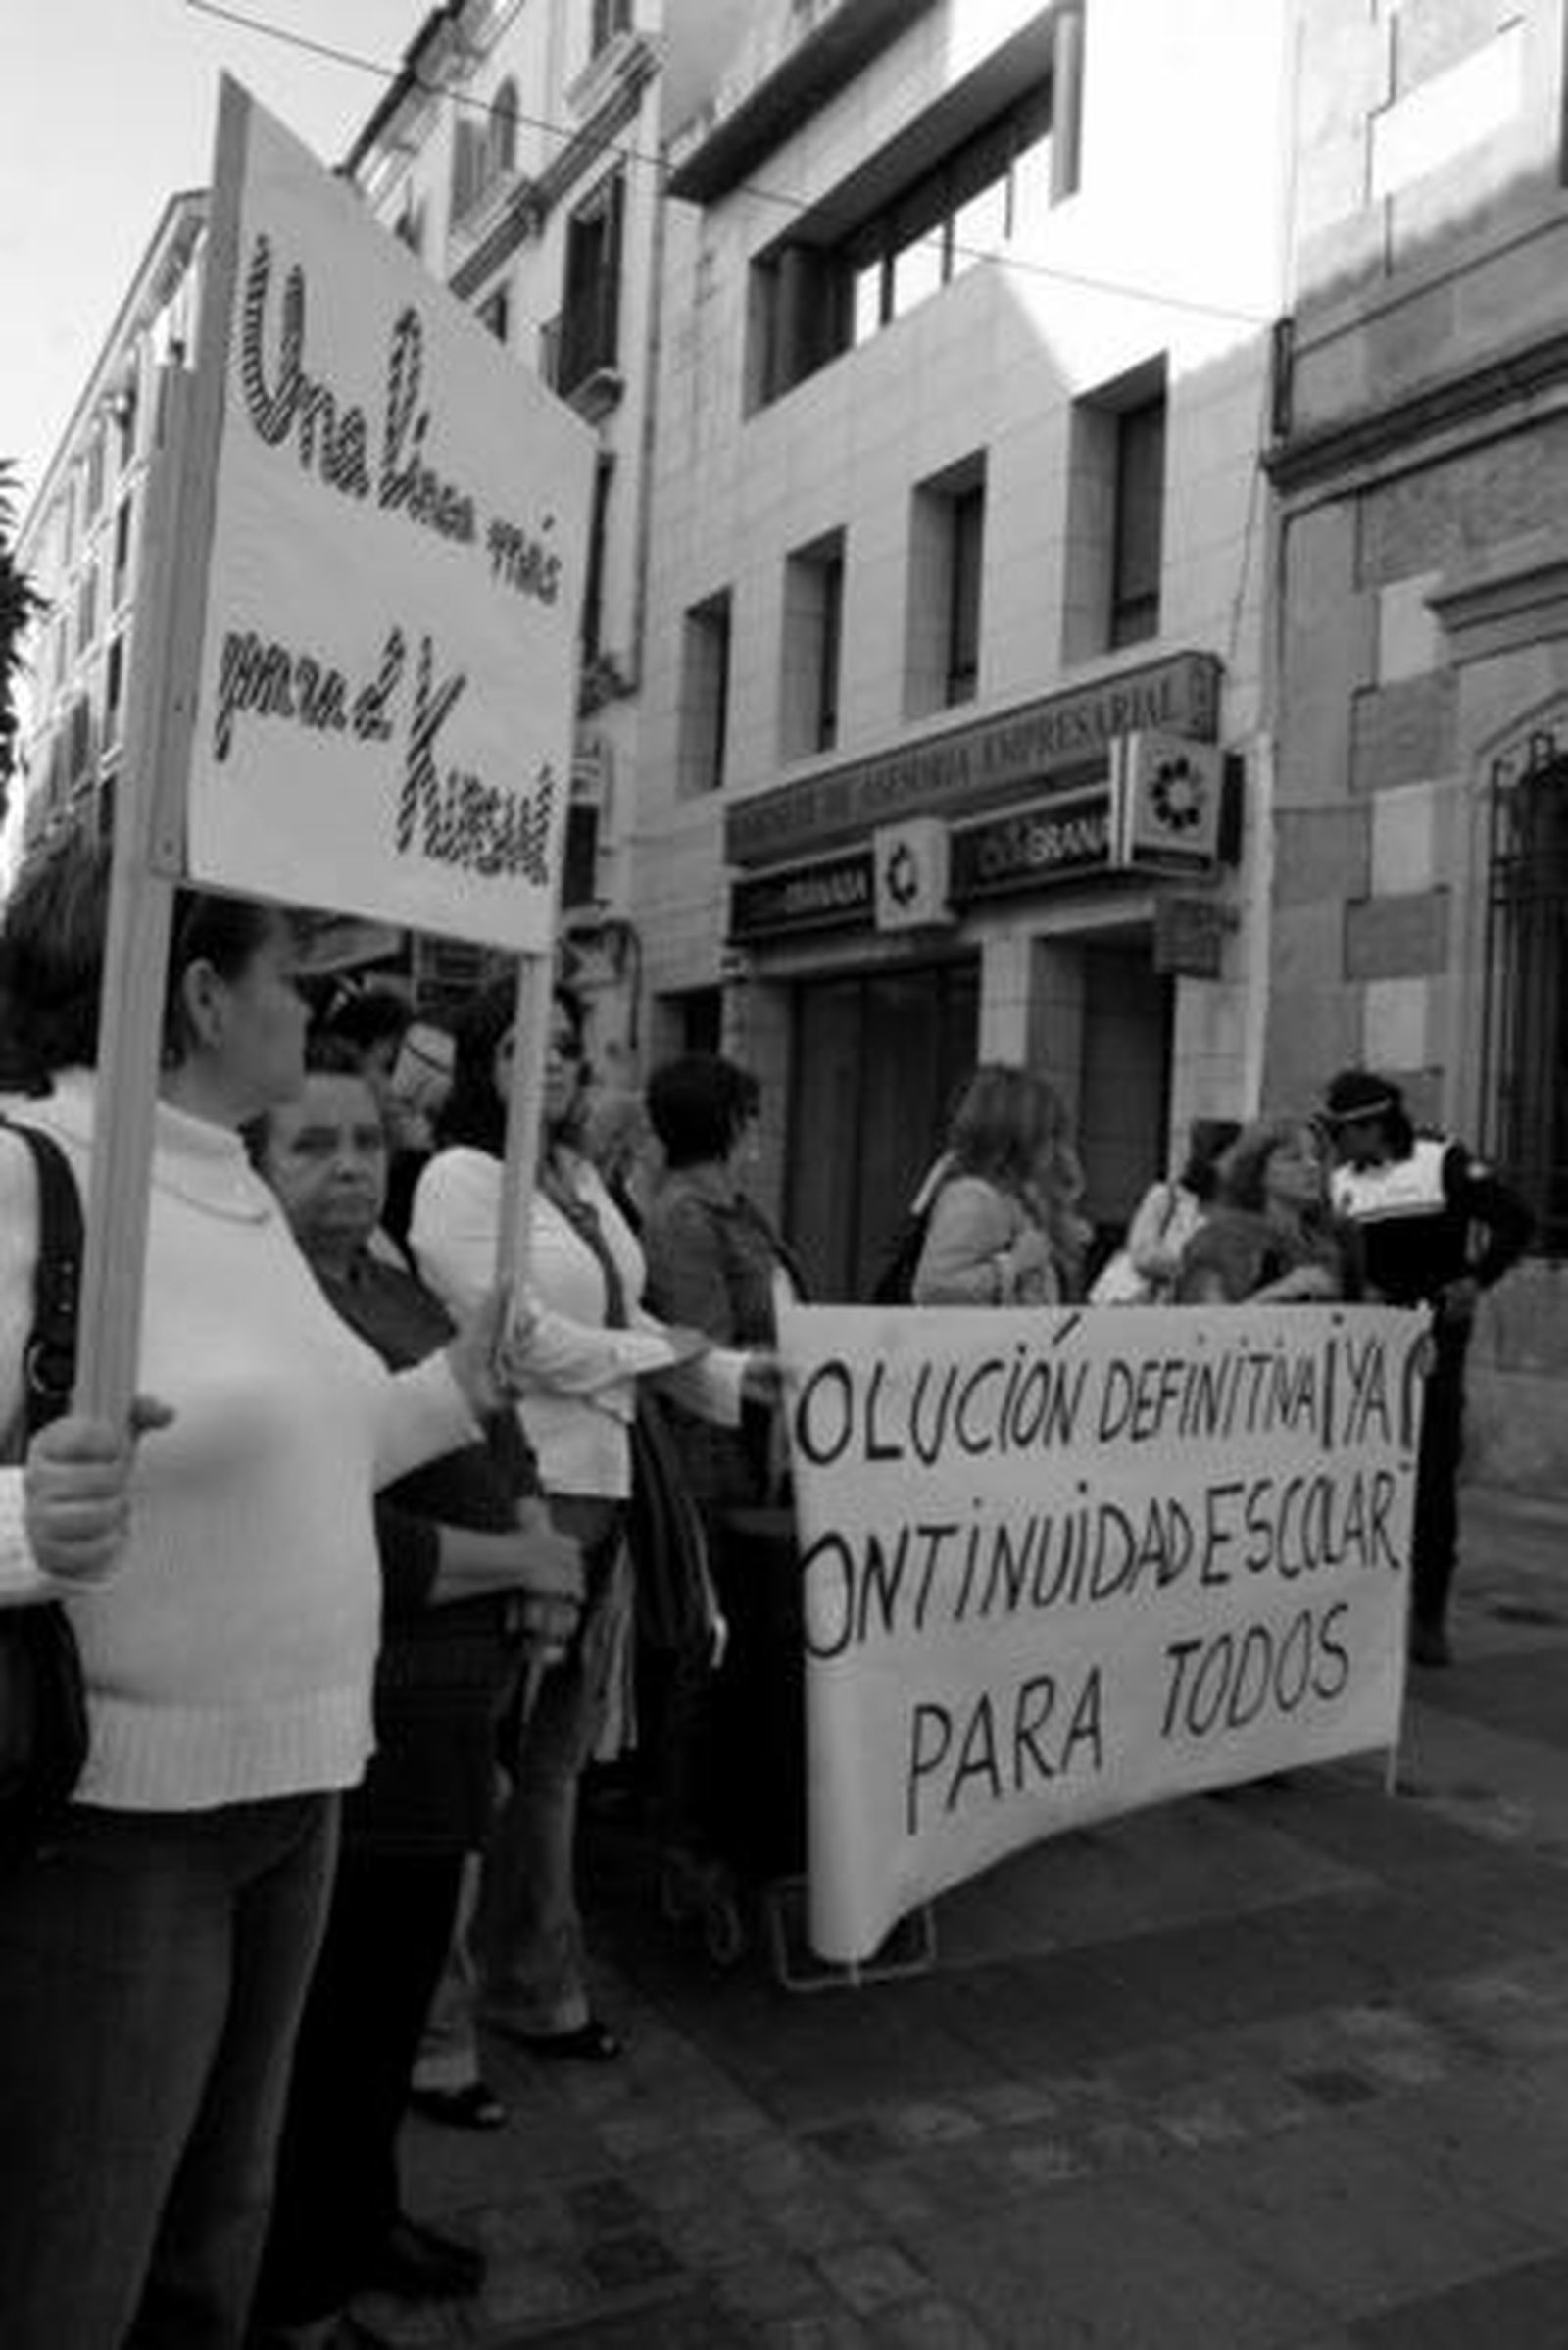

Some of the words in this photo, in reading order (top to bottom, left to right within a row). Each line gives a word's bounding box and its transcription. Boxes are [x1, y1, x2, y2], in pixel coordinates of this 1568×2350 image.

[243, 233, 370, 500] Una
[214, 630, 348, 762] para
[981, 678, 1176, 774] EMPRESARIAL
[1097, 1333, 1317, 1446] DEFINITIVA
[1200, 1469, 1401, 1586] ESCOLAR
[906, 1666, 1102, 1836] PARA
[1162, 1602, 1350, 1738] TODOS
